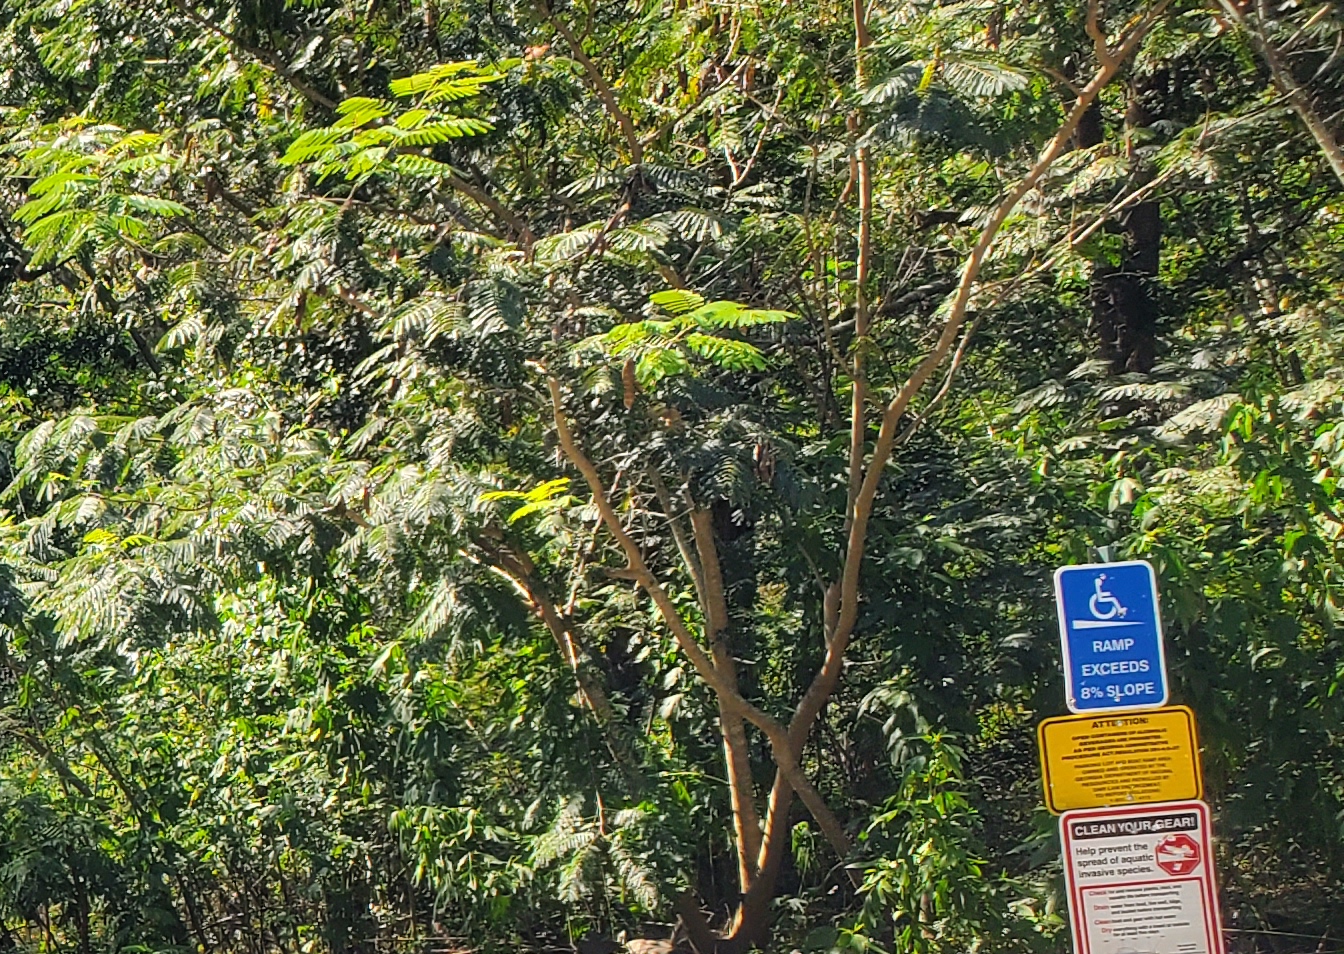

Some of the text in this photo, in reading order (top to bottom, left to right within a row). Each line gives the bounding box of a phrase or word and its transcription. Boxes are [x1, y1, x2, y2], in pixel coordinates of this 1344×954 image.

[1092, 638, 1134, 652] RAMP
[1081, 660, 1149, 676] EXCEEDS
[1081, 682, 1155, 699] 8% SLOPE
[1092, 718, 1149, 728] ATTETION:
[1075, 817, 1195, 836] CLEAN YOUR GEAR!
[1076, 847, 1096, 856] Help
[1098, 844, 1132, 855] prevent
[1077, 854, 1154, 868] spread of aquatic
[1079, 865, 1154, 878] invasive species.
